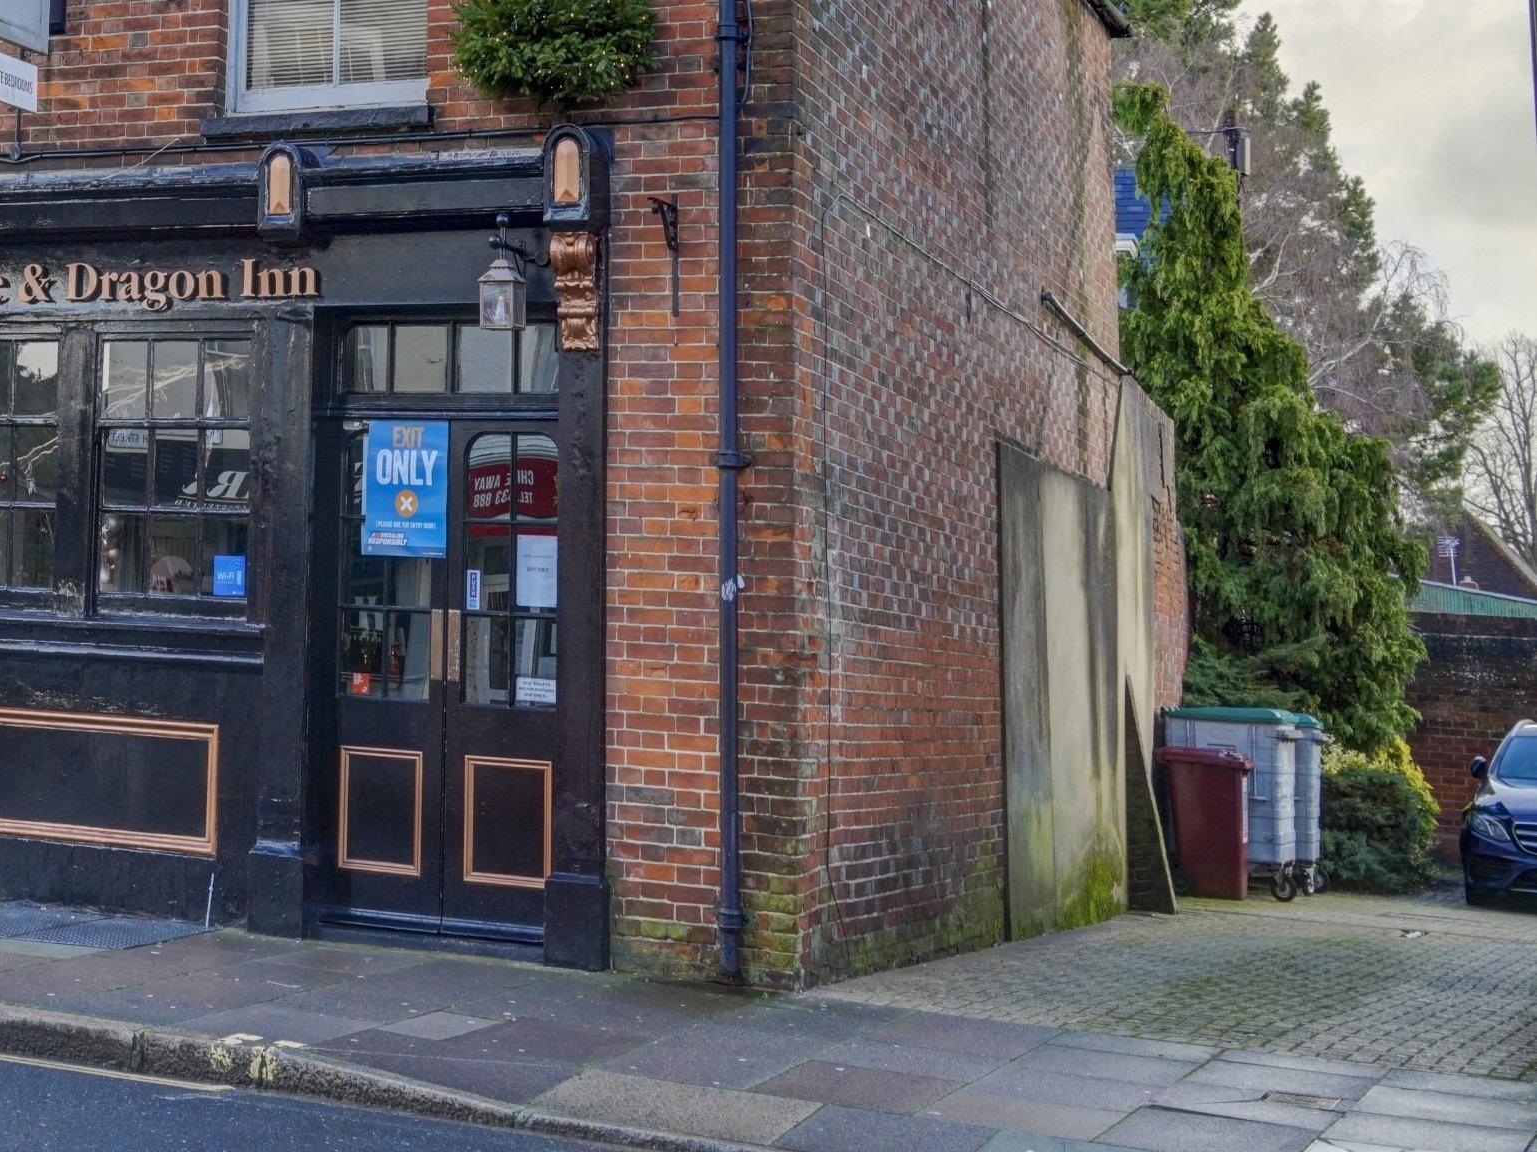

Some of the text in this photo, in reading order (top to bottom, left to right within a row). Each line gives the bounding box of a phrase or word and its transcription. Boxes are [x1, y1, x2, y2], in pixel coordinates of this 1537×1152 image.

[19, 263, 53, 302] &
[65, 262, 226, 311] Dragon
[240, 258, 320, 298] Inn
[393, 427, 424, 448] EXIT
[376, 449, 438, 486] ONLY
